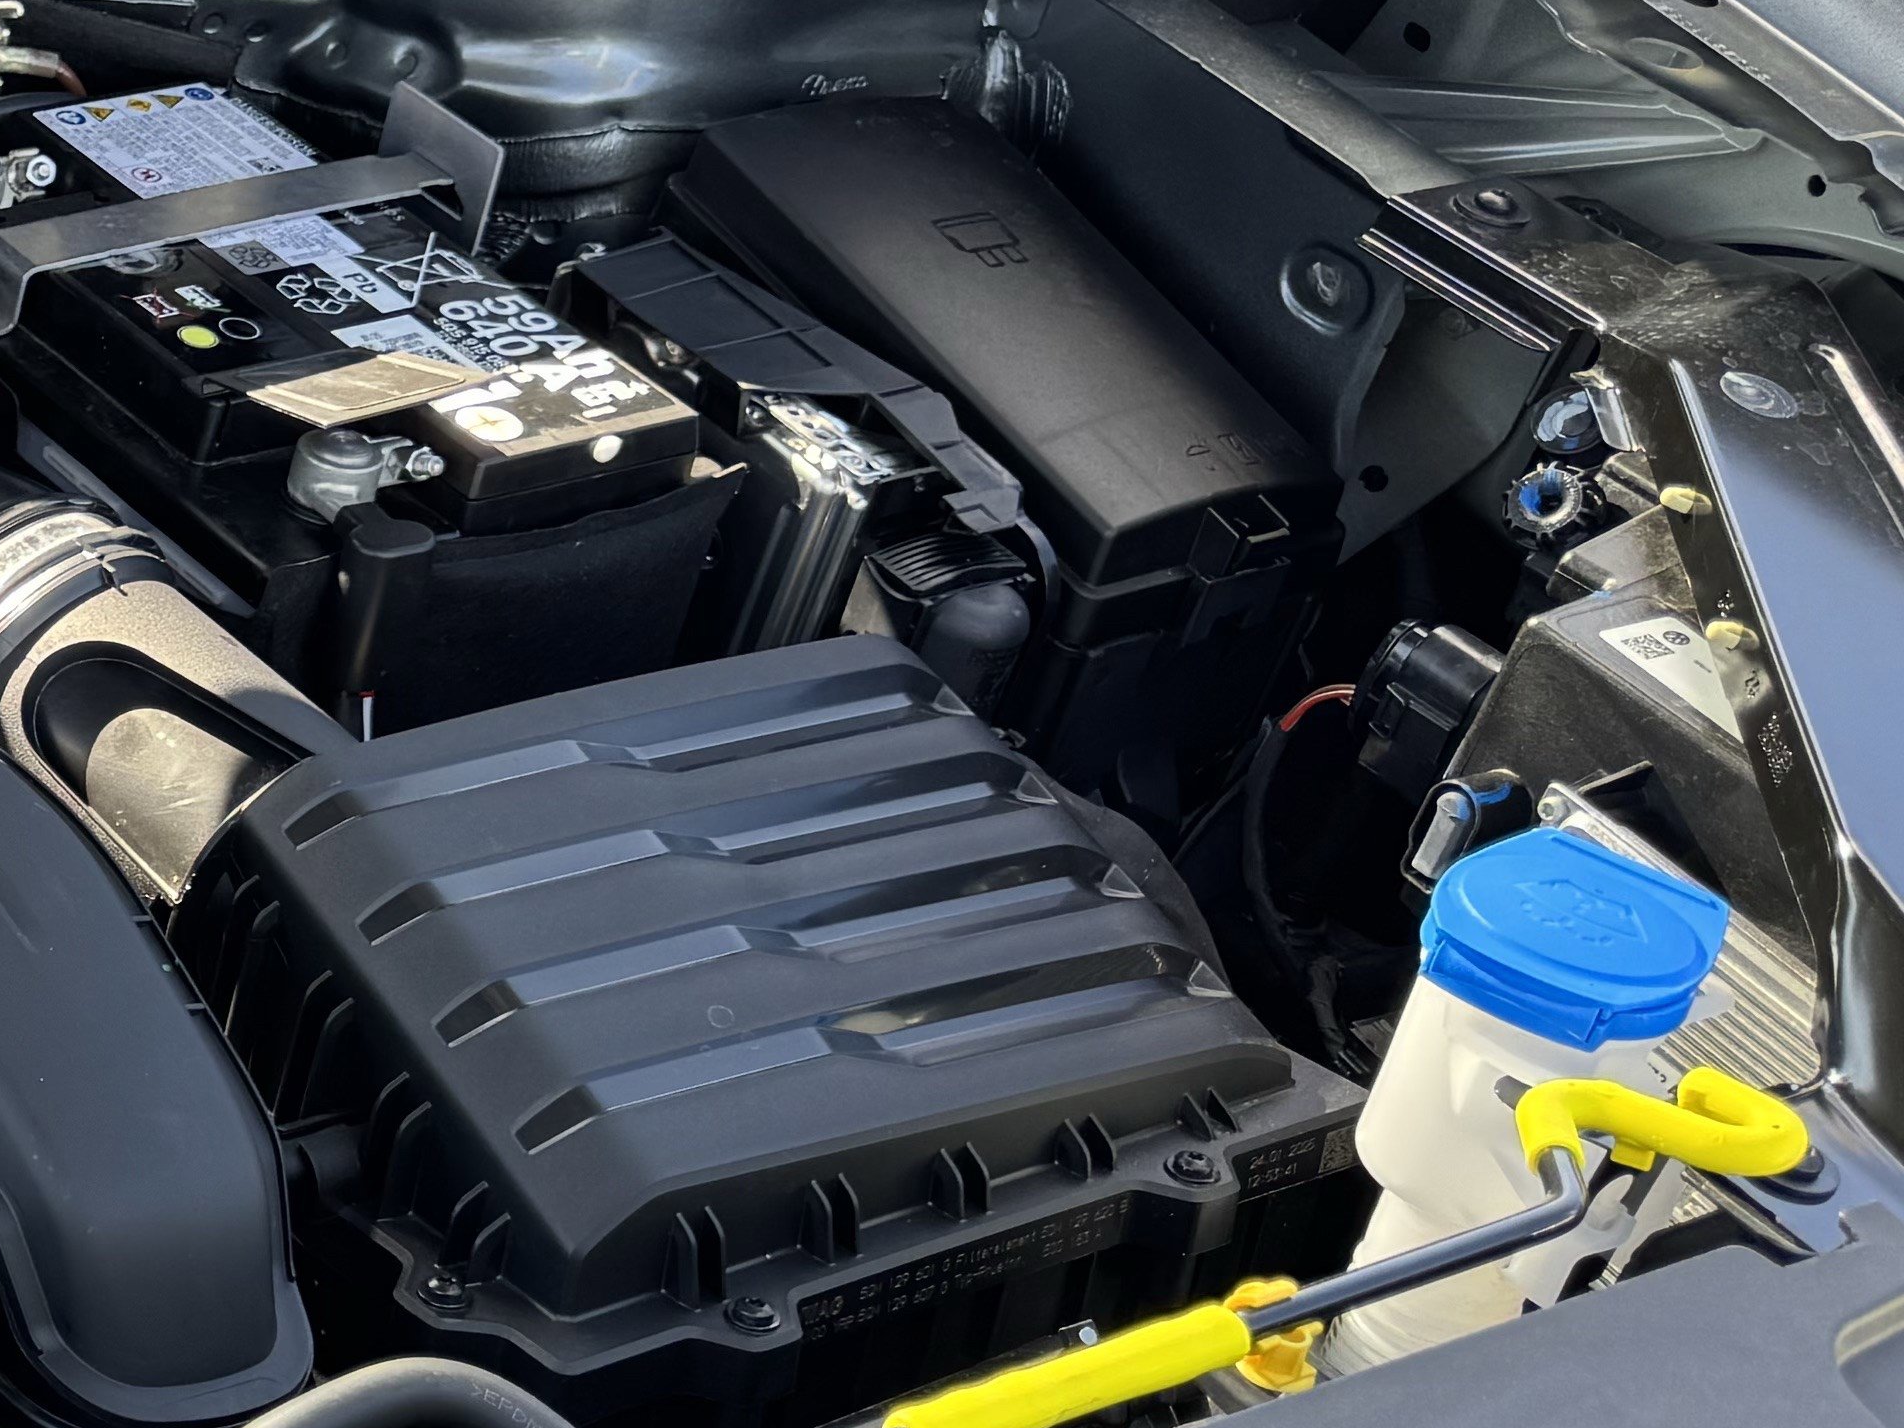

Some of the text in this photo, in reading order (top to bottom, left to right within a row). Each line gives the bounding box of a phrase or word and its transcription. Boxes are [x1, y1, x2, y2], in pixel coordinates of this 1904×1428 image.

[343, 273, 378, 294] Pb
[439, 300, 539, 356] 640
[482, 294, 616, 379] 59Ah
